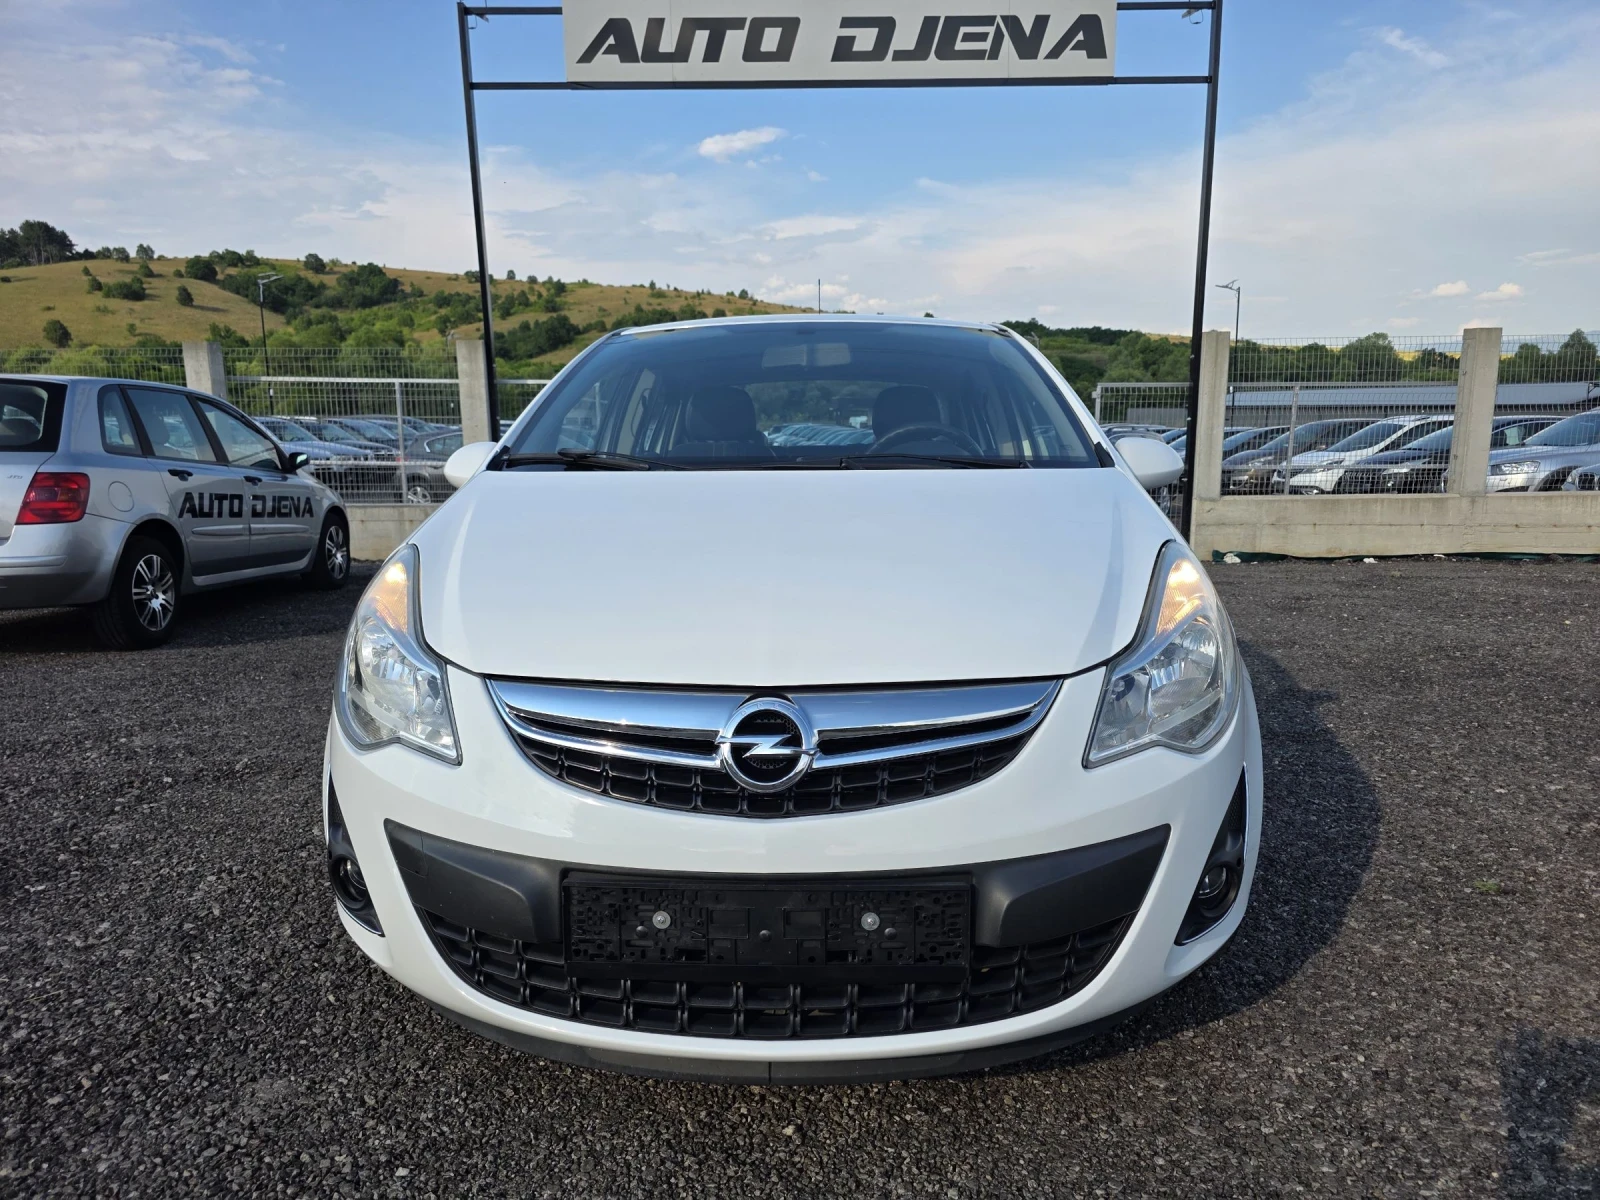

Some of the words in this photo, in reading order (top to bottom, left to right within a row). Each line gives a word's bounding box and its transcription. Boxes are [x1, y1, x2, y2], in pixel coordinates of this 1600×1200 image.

[576, 17, 801, 64] AUTO
[830, 14, 1108, 63] DJENA
[178, 492, 244, 519] AUTO
[251, 494, 315, 518] DJENA
